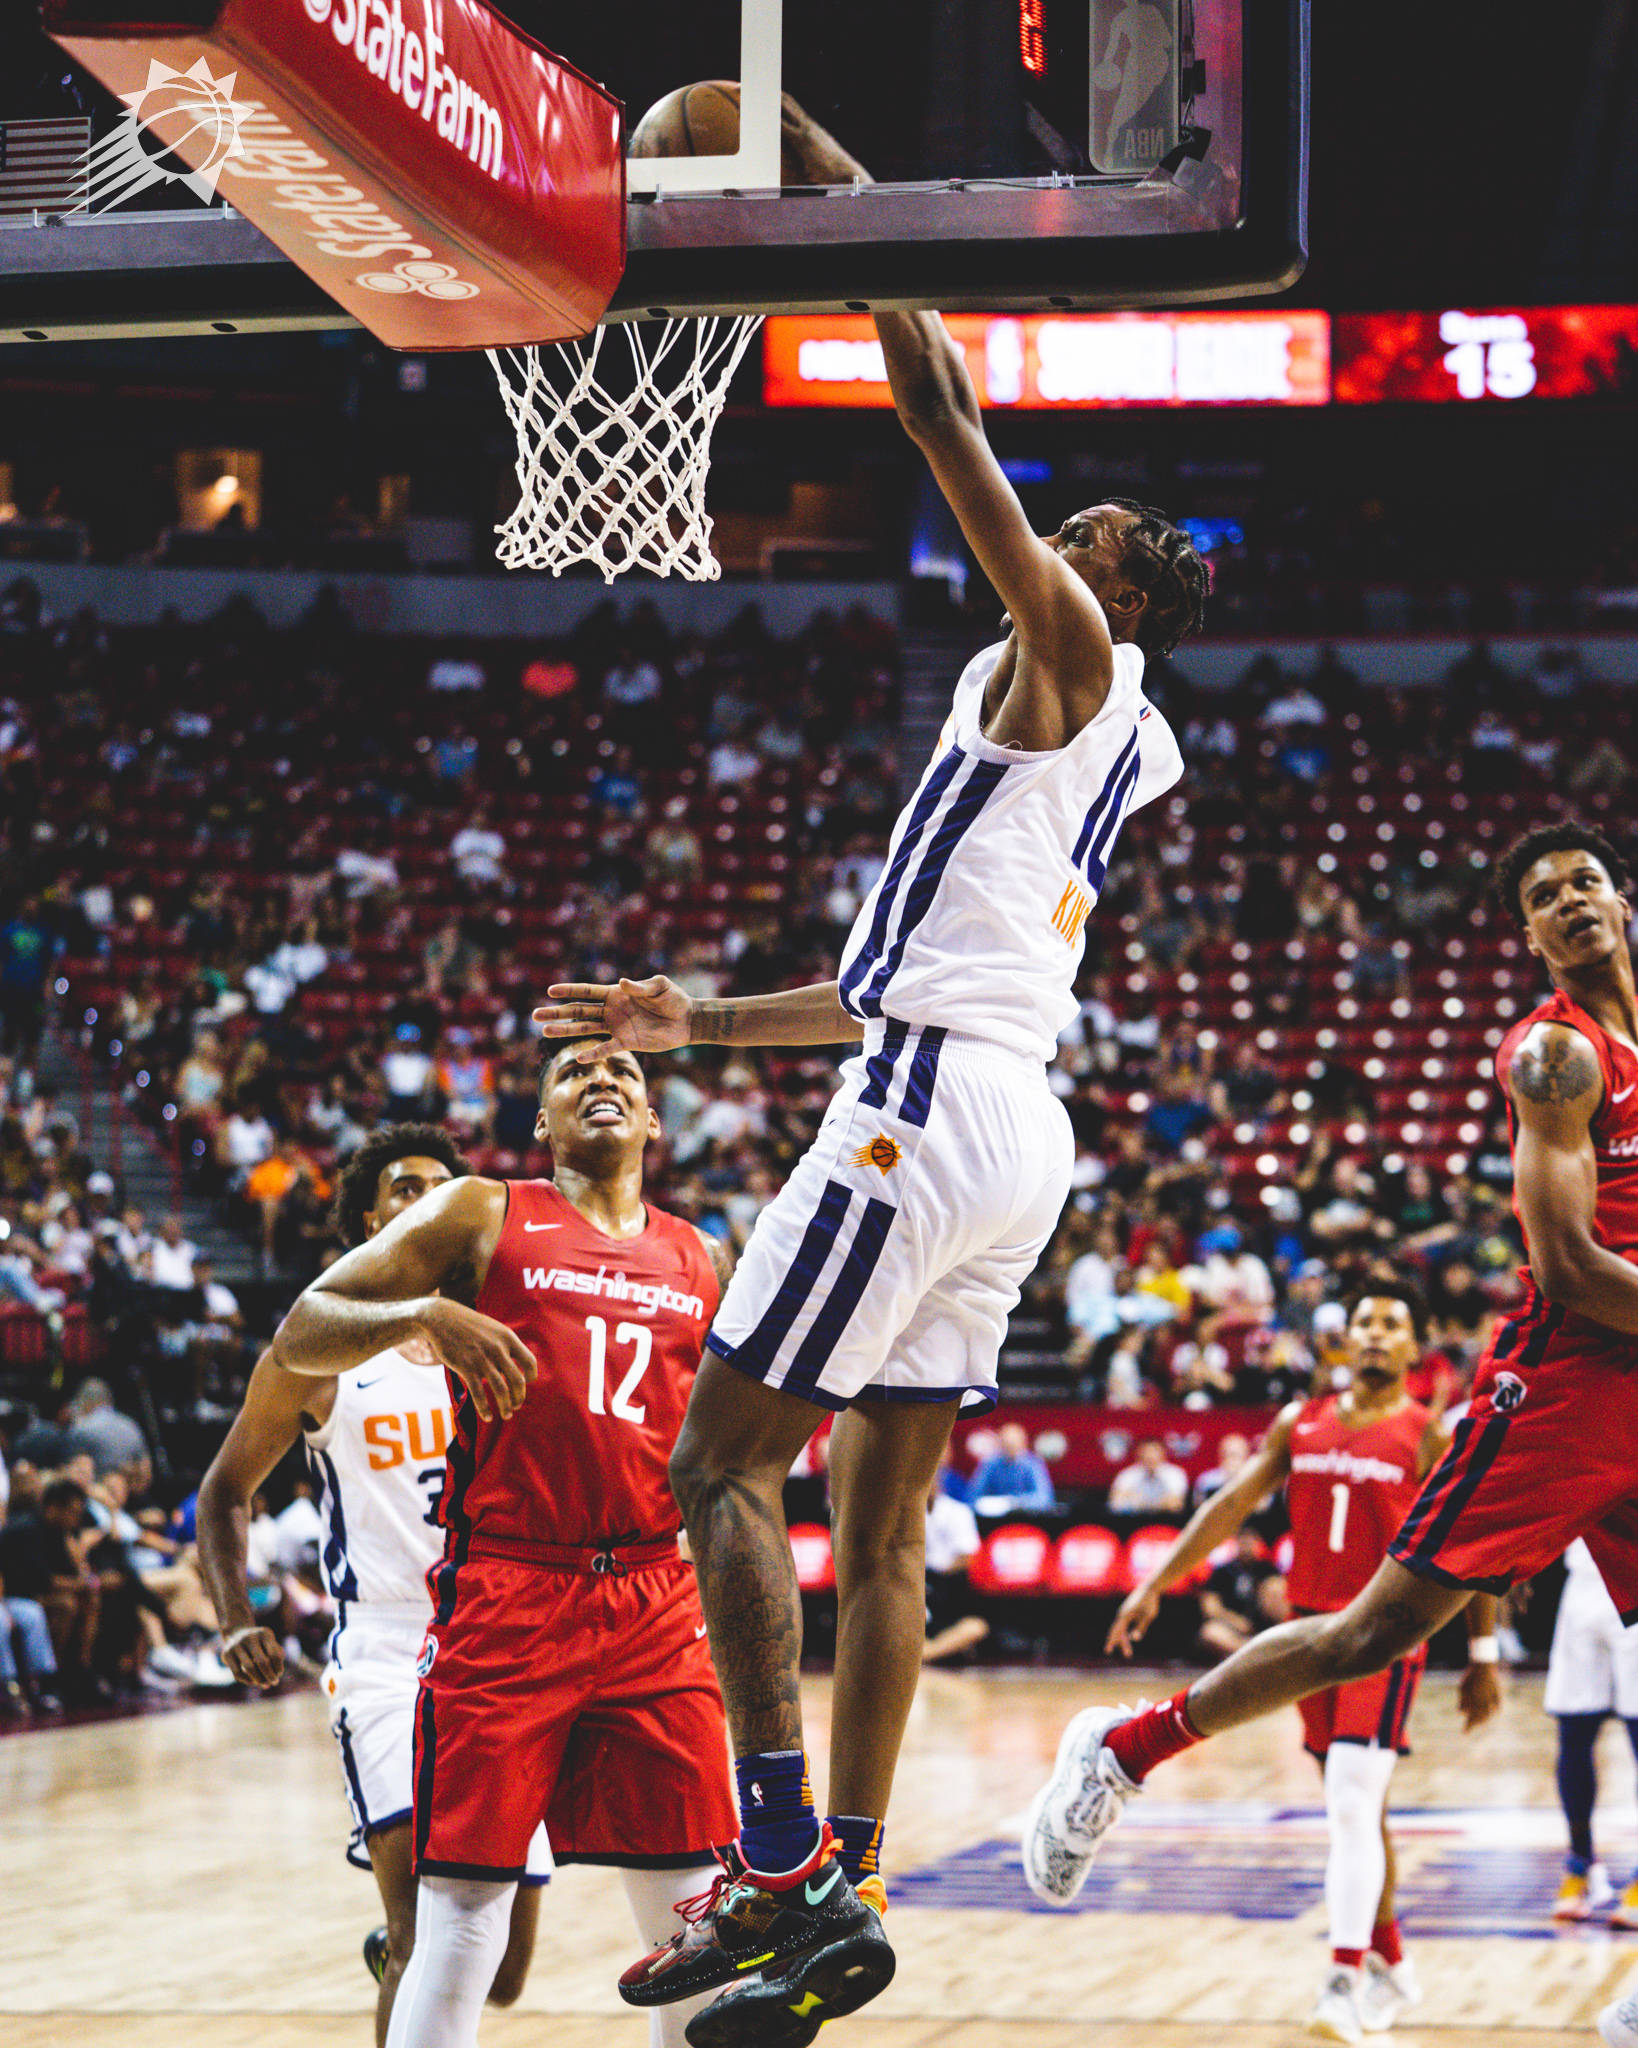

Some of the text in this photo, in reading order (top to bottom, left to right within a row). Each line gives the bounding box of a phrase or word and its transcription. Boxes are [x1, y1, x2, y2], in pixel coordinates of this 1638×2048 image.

[1443, 342, 1537, 399] 15
[522, 1265, 704, 1320] washington
[585, 1315, 652, 1424] 12
[1328, 1483, 1350, 1553] 1
